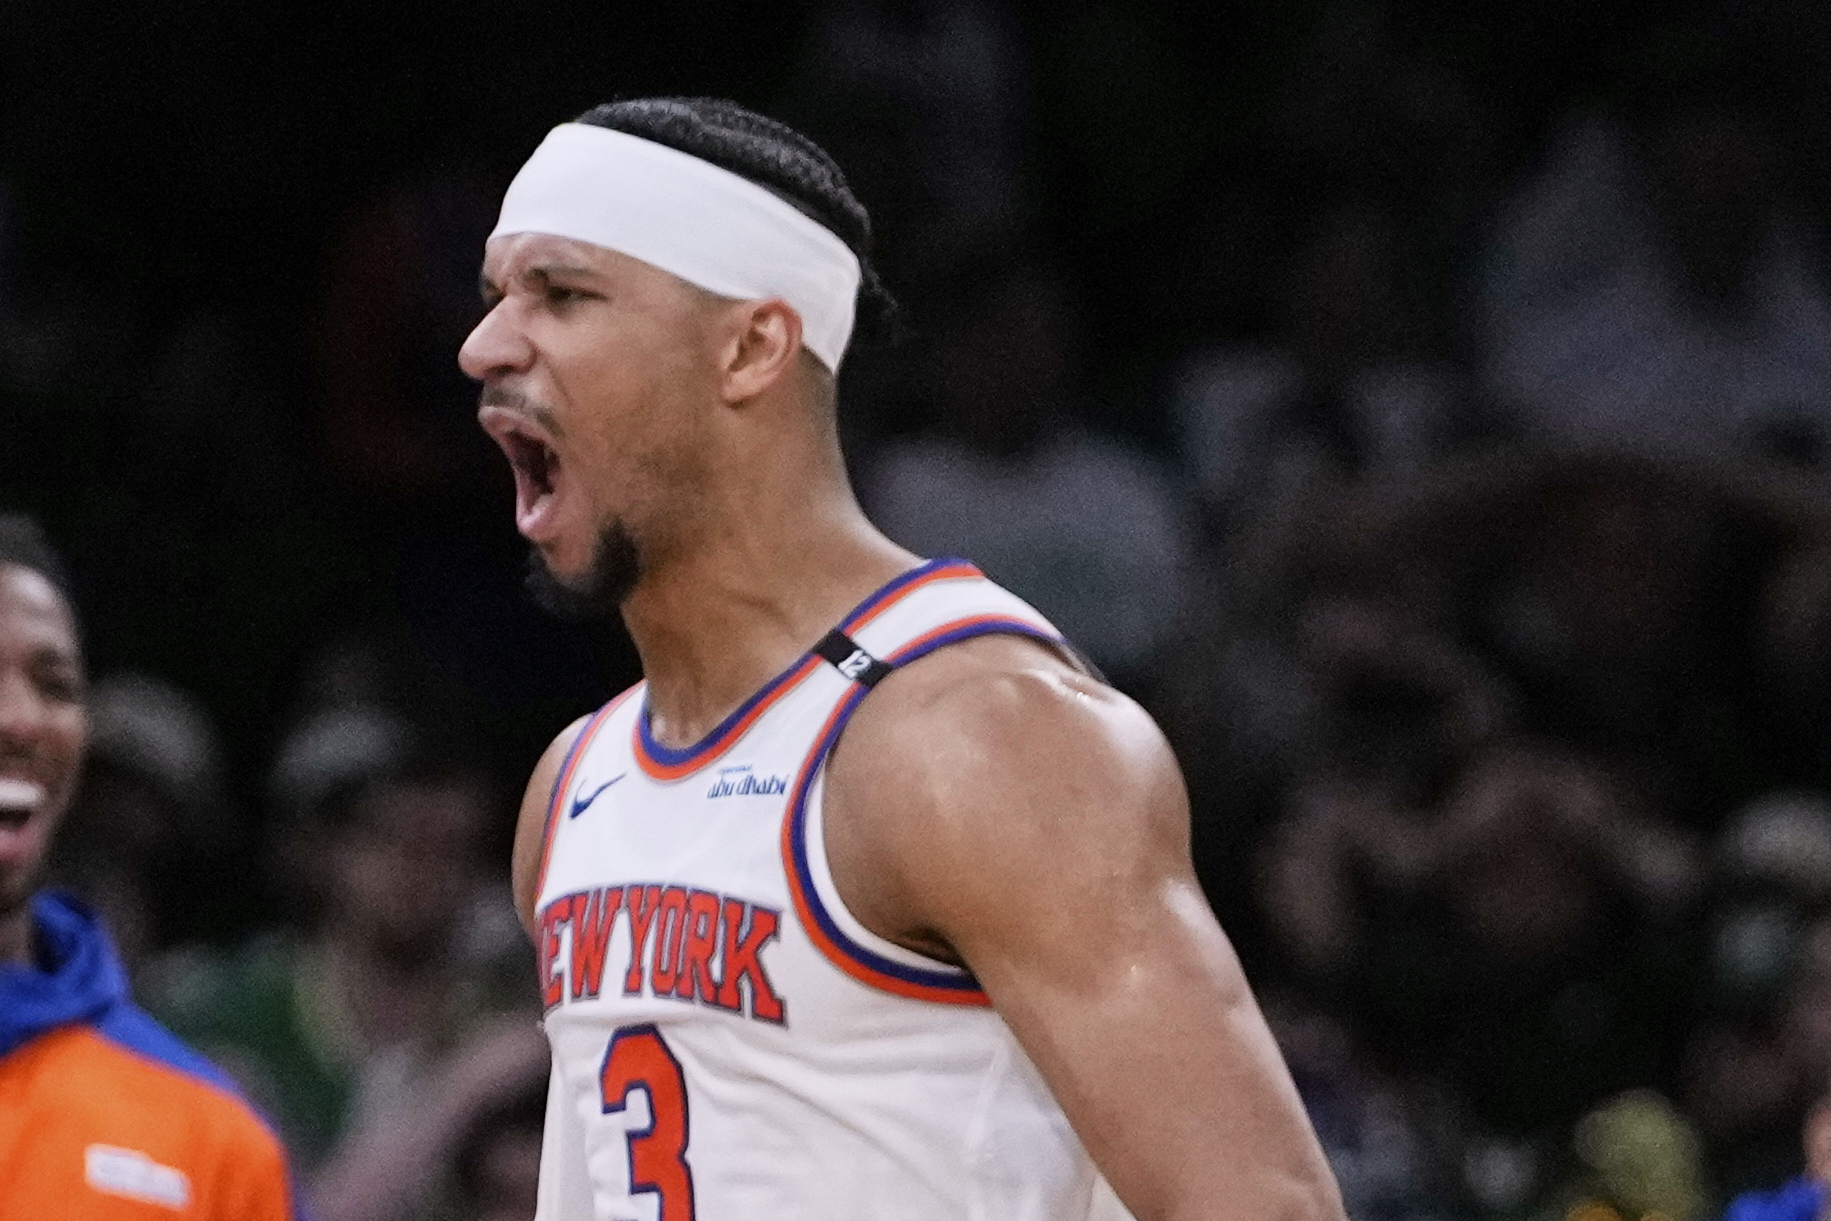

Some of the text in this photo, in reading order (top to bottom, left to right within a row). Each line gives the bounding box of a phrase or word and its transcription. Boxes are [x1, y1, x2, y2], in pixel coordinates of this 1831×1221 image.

[837, 649, 871, 679] 12
[536, 883, 788, 1027] EW YORK
